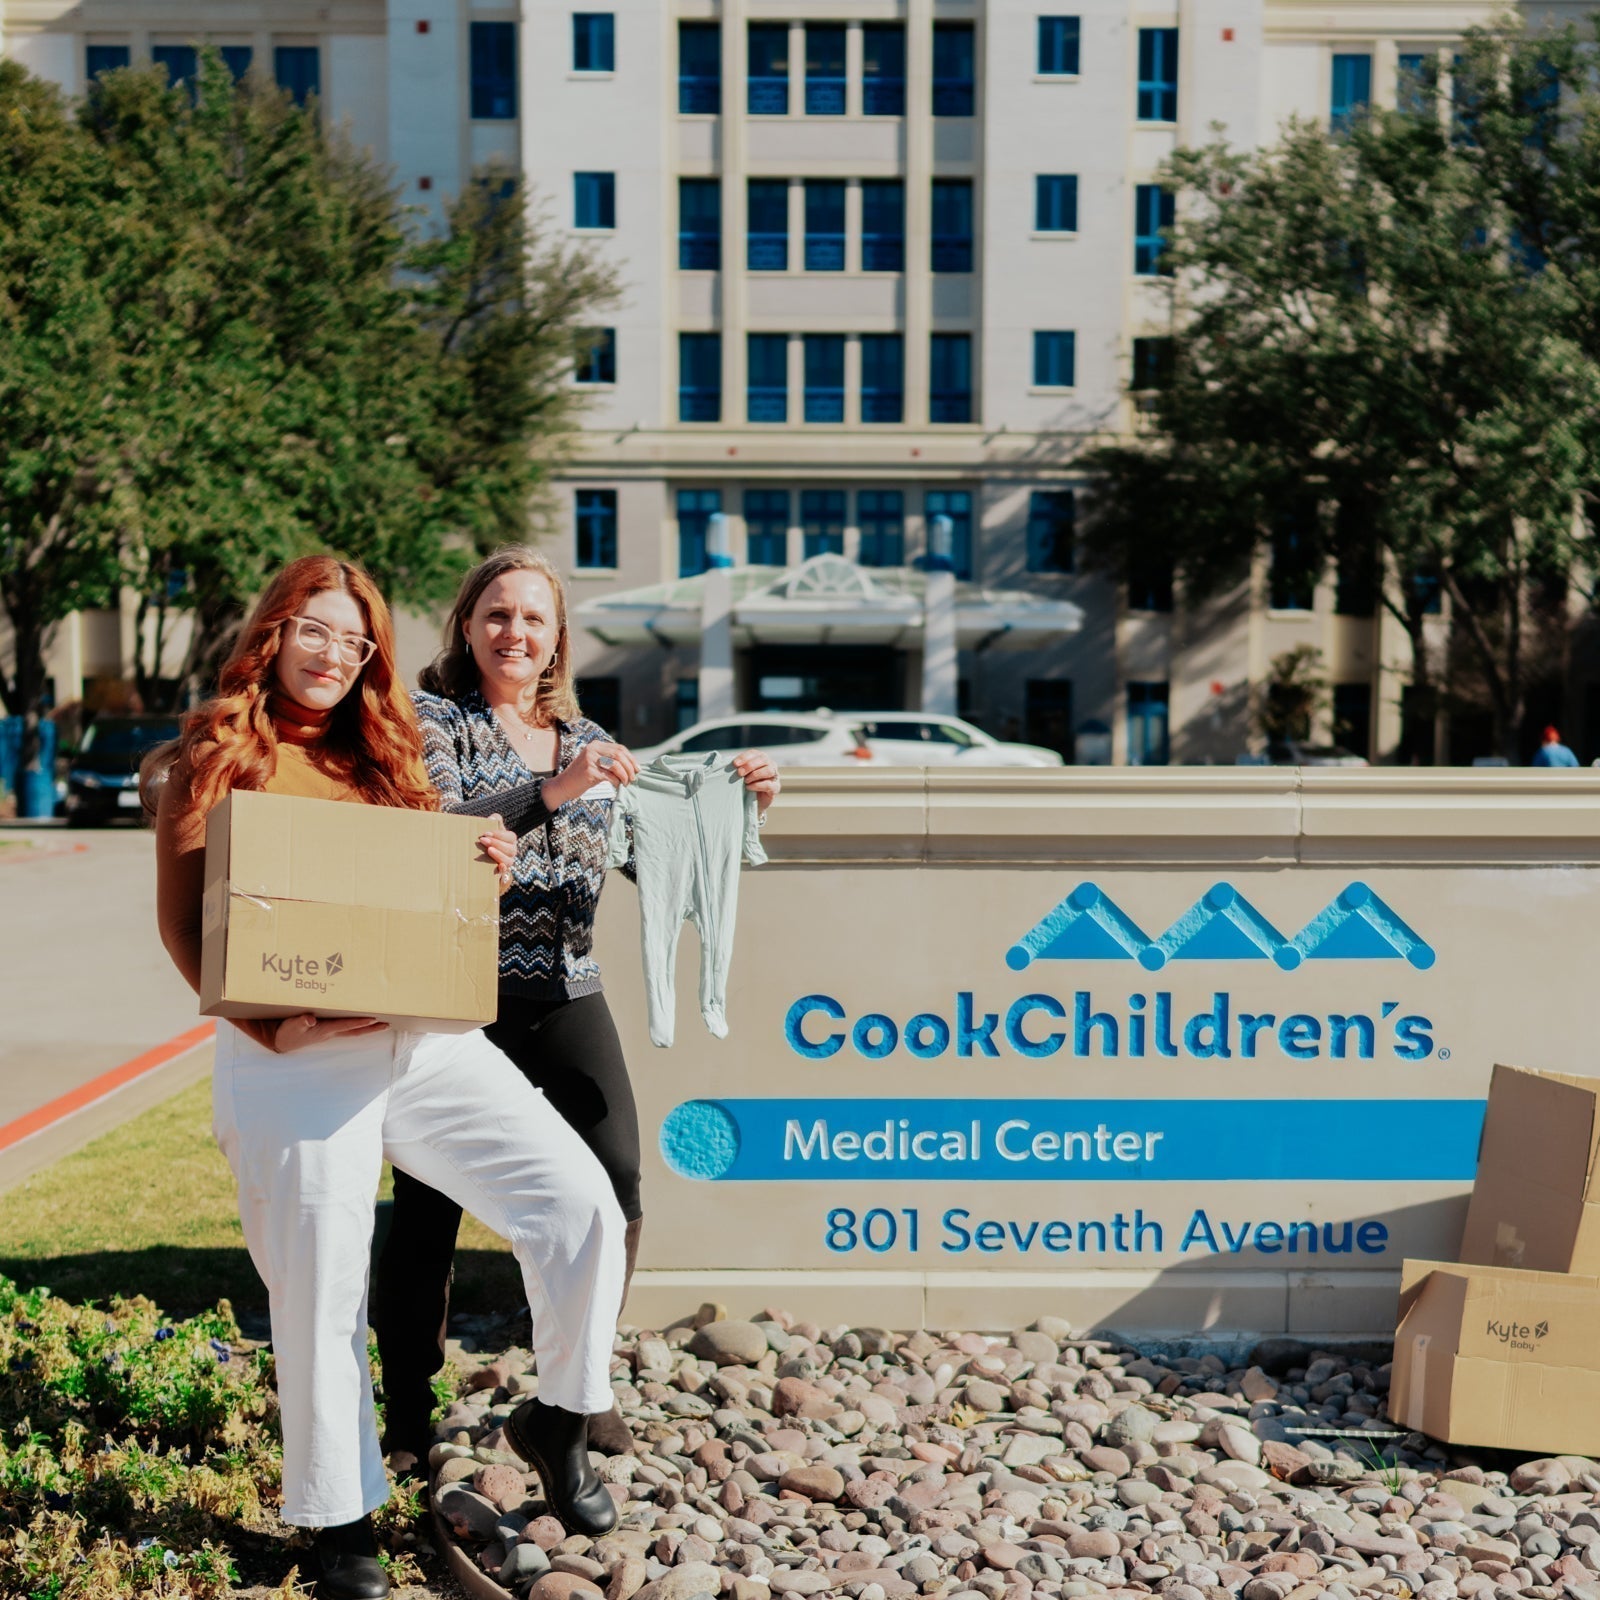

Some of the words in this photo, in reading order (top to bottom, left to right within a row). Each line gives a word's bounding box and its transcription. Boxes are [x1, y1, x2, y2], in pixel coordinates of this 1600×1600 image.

[261, 952, 320, 982] Kyte
[295, 978, 327, 994] Baby
[783, 1119, 981, 1161] Medical
[995, 1119, 1164, 1161] Center
[824, 1207, 919, 1253] 801
[939, 1207, 1164, 1253] Seventh
[1177, 1208, 1389, 1254] Avenue
[1486, 1319, 1530, 1343] Kyte
[1510, 1340, 1535, 1353] Baby
